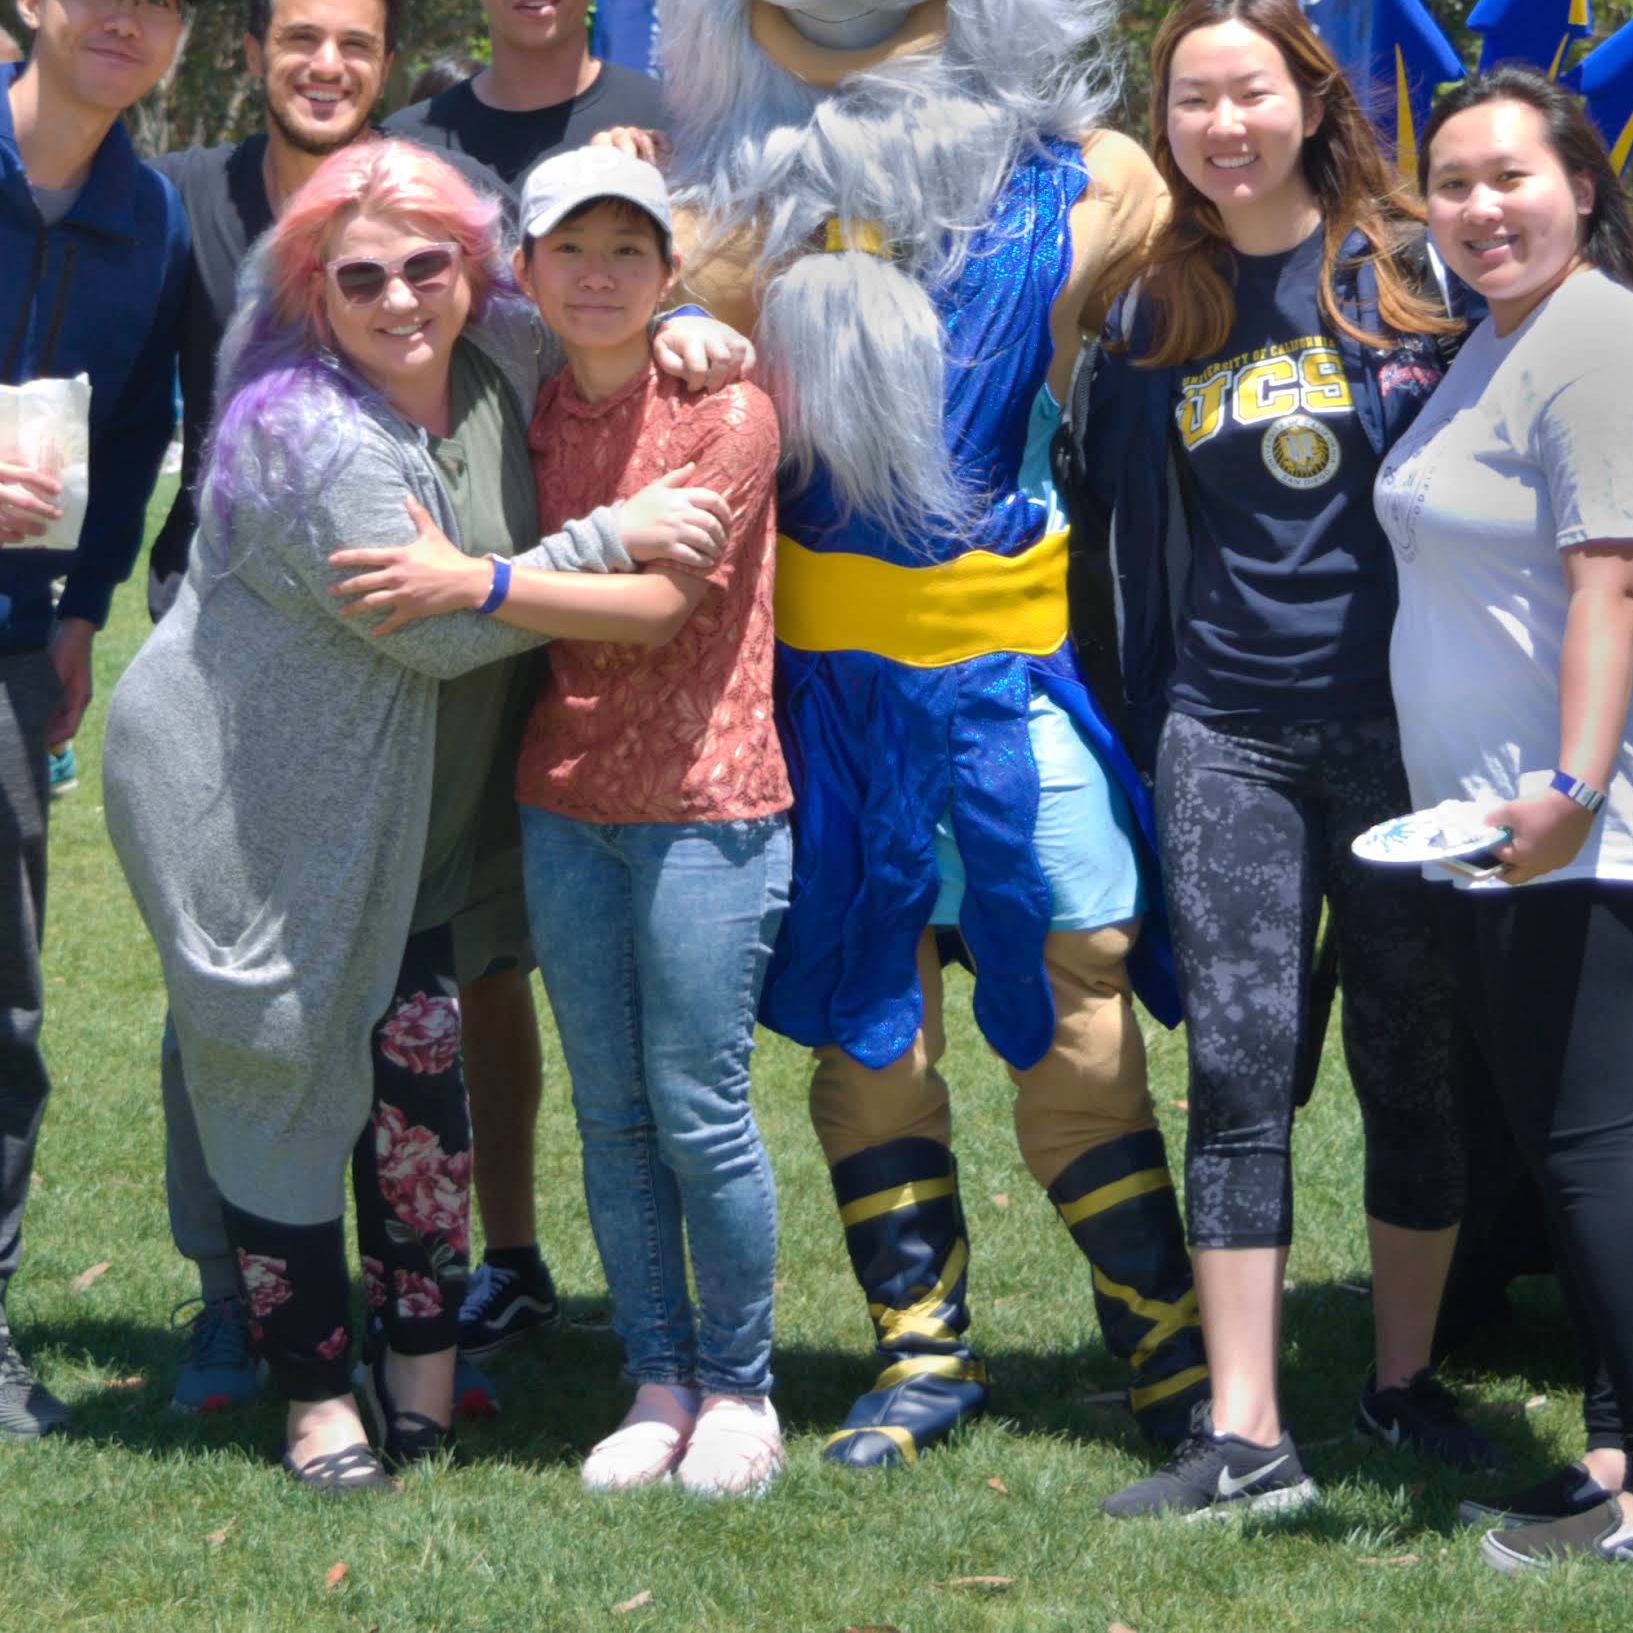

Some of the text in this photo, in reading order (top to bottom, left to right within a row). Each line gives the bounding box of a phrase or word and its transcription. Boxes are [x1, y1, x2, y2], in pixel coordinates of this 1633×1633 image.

[1182, 335, 1337, 387] UNIVERSITY OF CALIFORNIA
[1281, 468, 1331, 486] SAN DIEGO
